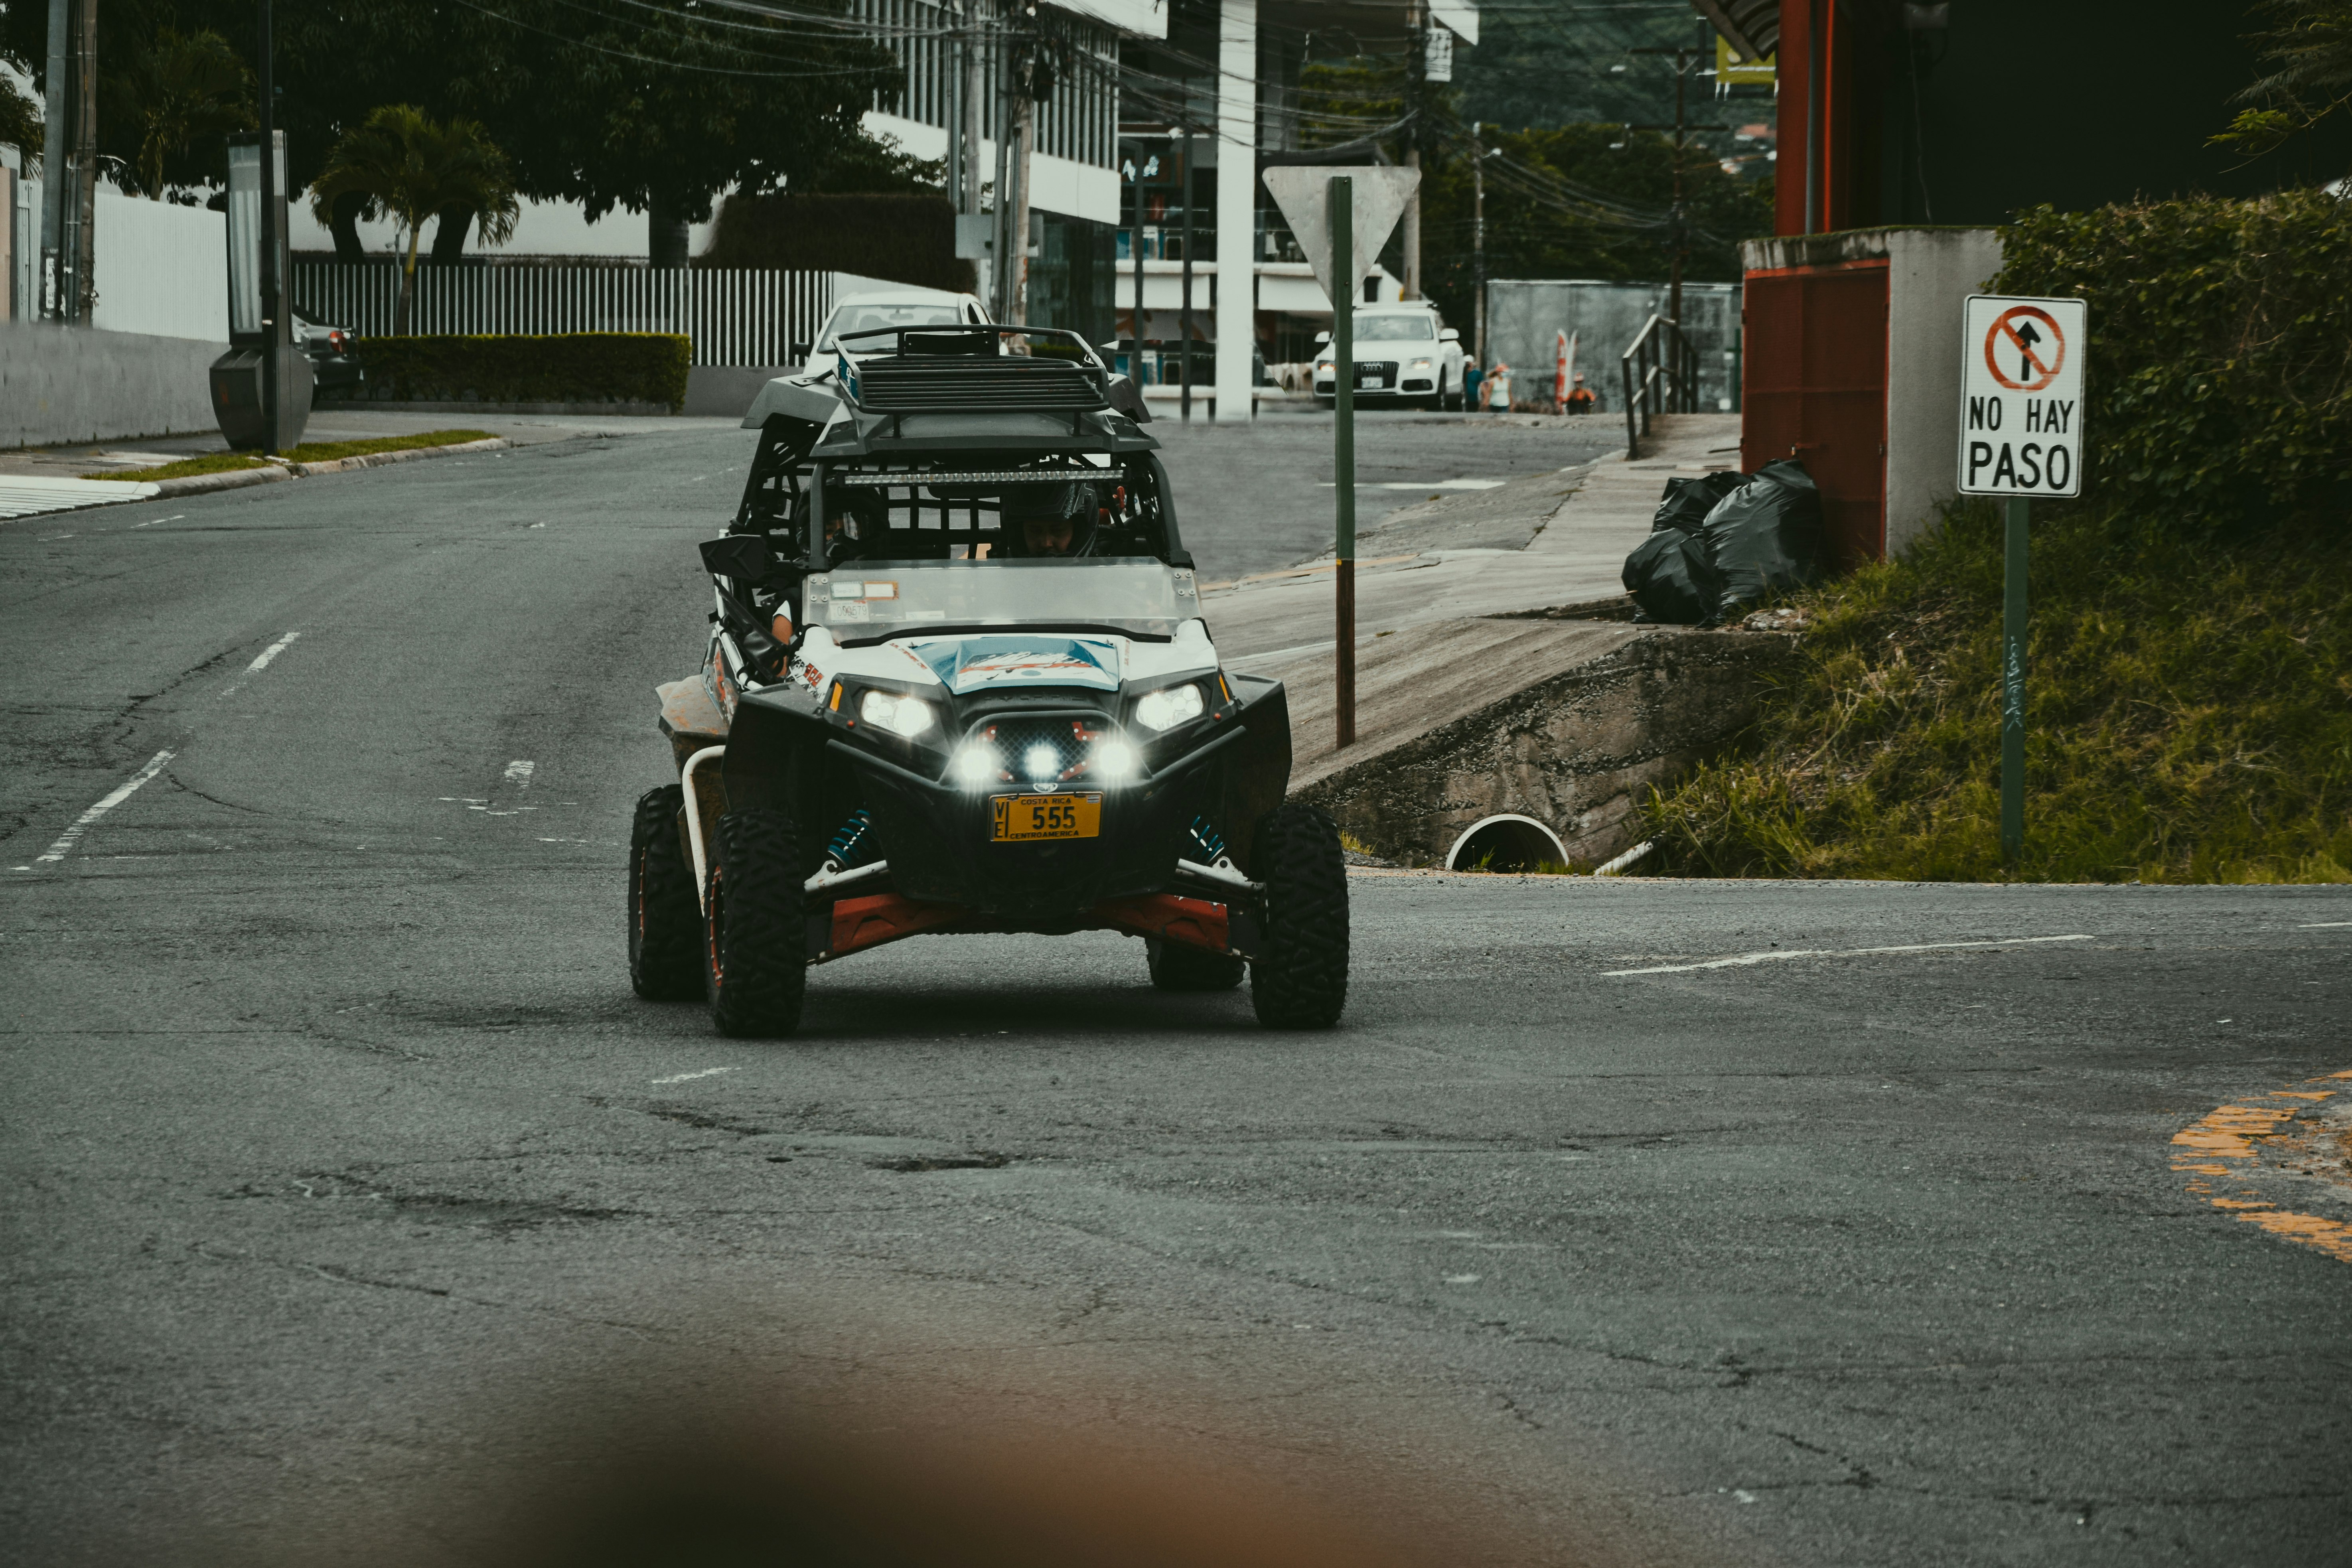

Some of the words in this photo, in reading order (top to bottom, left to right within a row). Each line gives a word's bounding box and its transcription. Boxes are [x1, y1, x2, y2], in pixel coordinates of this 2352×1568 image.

[1969, 396, 2001, 431] NO
[2026, 398, 2074, 434] HAY
[1969, 441, 2070, 490] PASO
[1033, 806, 1076, 830] 555
[1010, 830, 1079, 839] CENTROAMERICA
